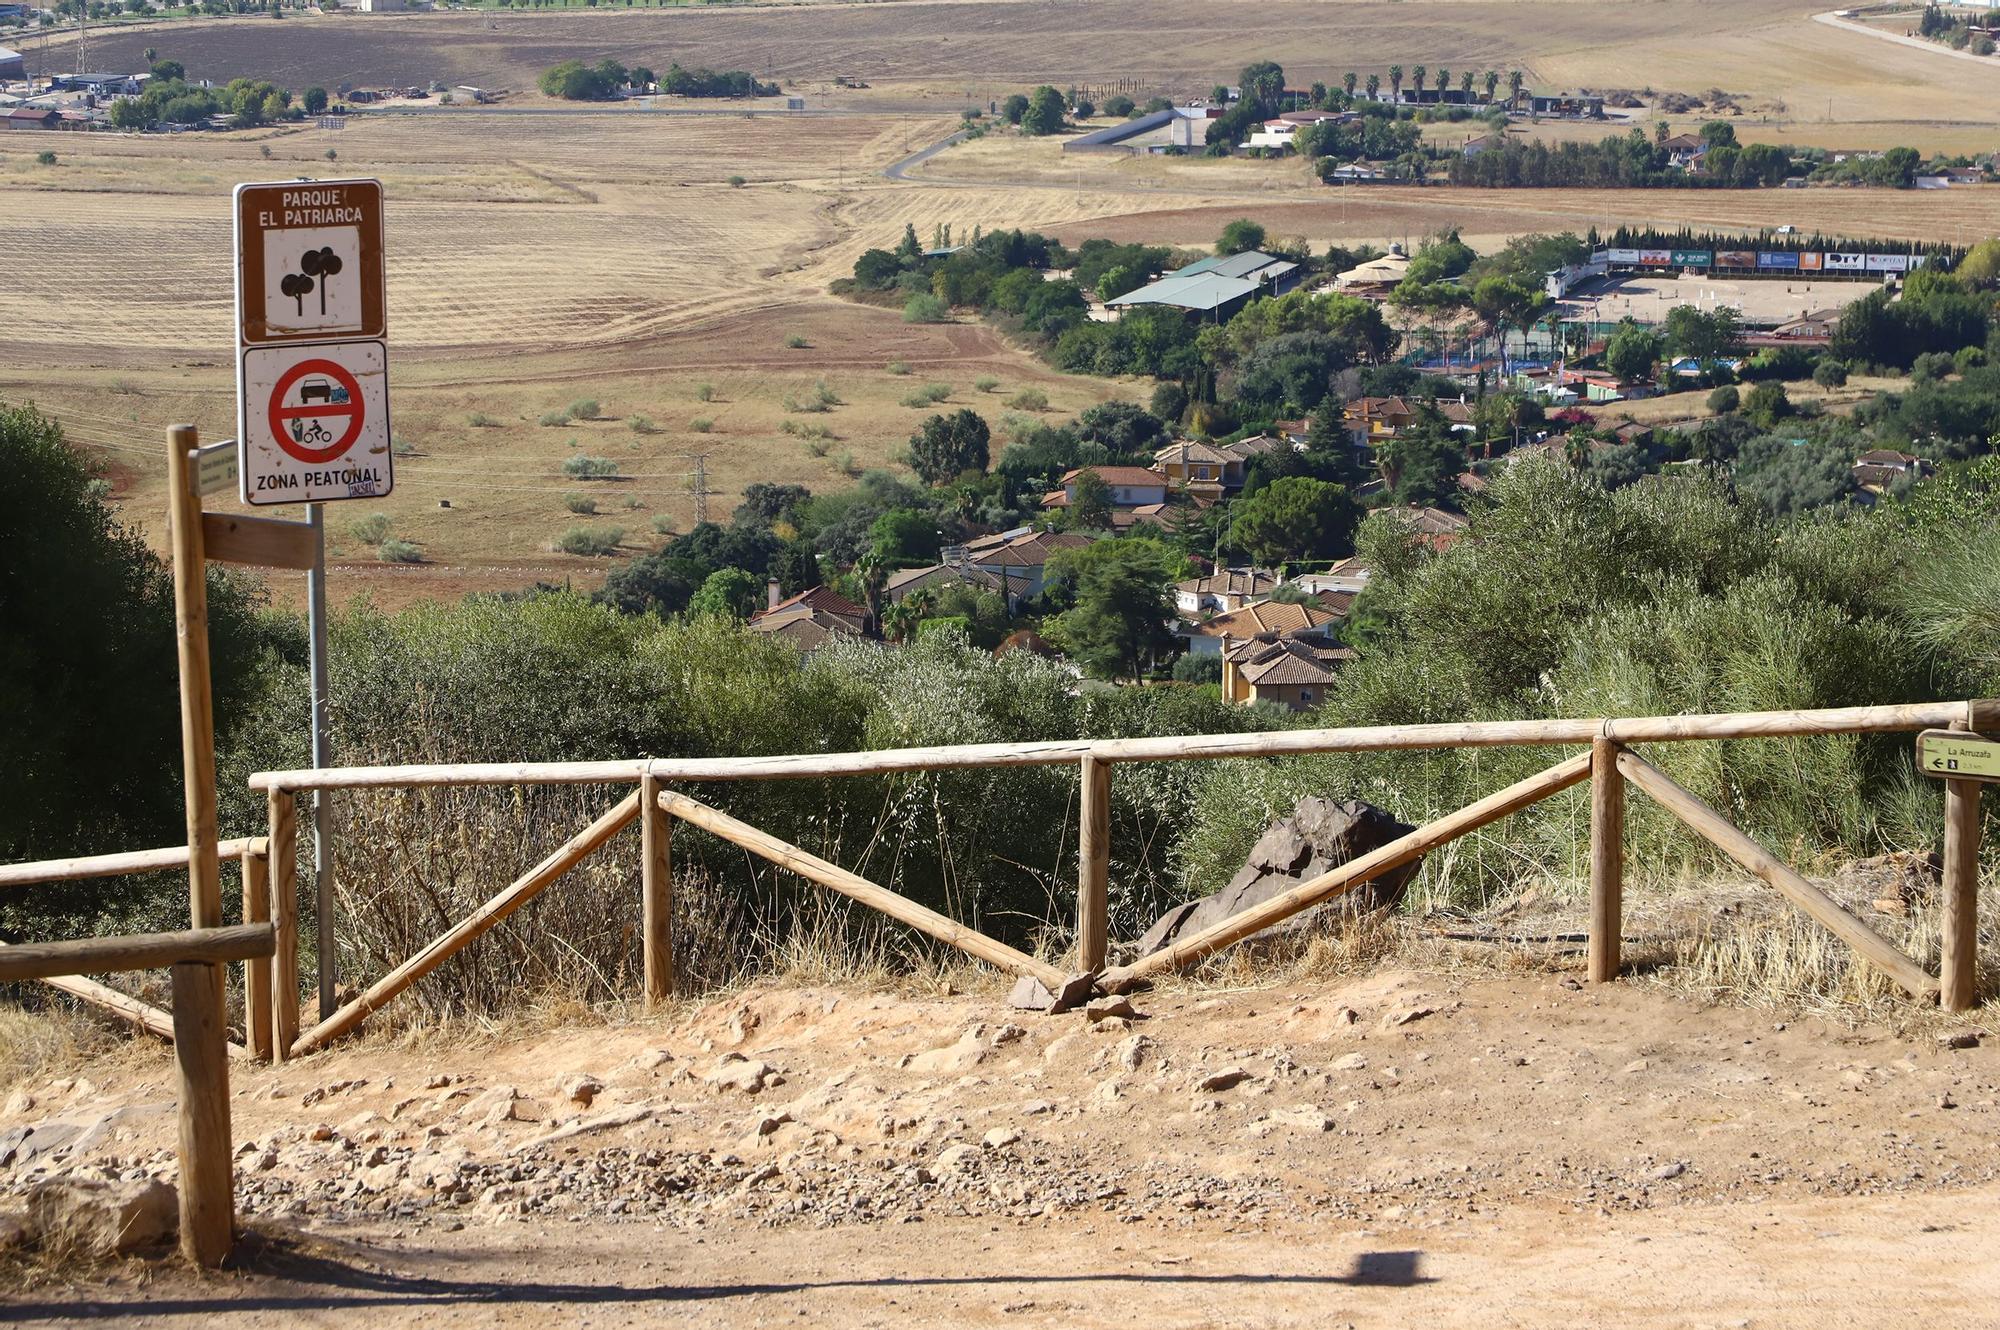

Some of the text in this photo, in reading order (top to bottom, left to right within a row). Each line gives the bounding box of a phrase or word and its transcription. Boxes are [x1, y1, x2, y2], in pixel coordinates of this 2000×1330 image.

[282, 190, 341, 207] PARQUE
[259, 207, 364, 227] EL PATRIARCA
[257, 467, 382, 491] ZONA PEATONAL
[1948, 747, 1991, 758] La Arruzafa
